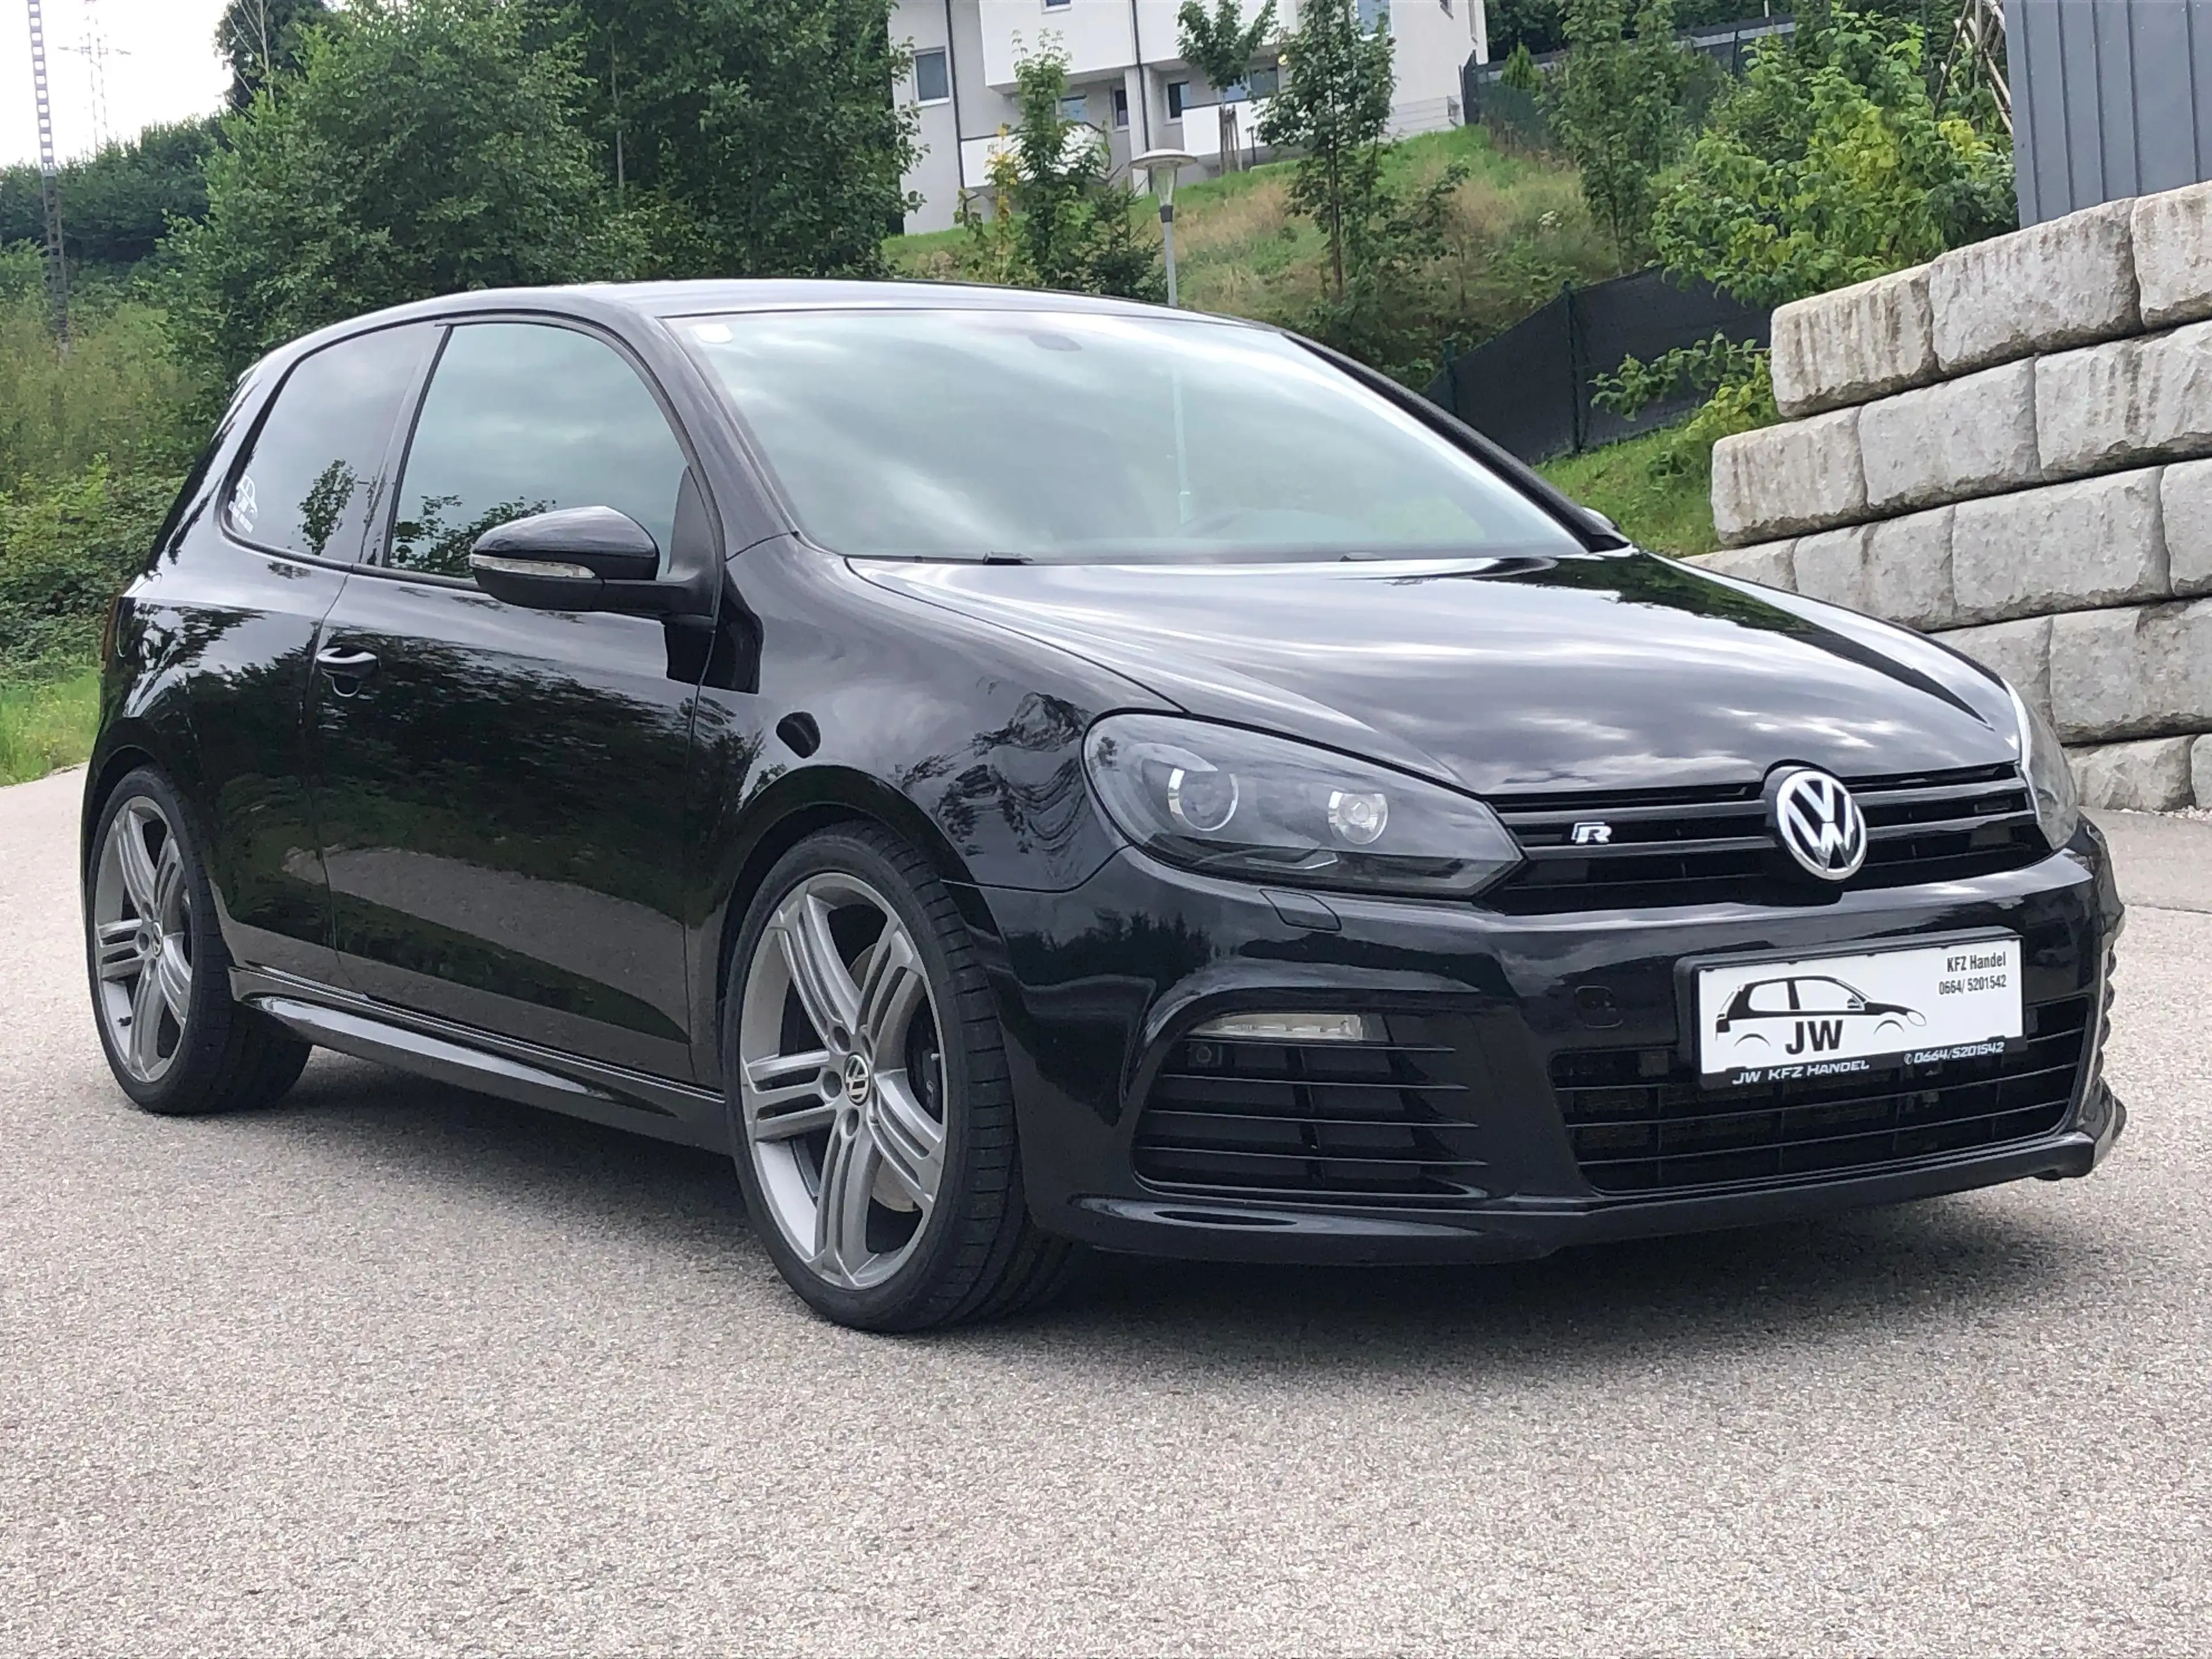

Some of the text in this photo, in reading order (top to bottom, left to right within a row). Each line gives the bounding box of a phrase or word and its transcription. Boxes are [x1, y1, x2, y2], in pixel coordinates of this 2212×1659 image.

[1571, 821, 1612, 844] R
[1947, 951, 2006, 972] KFZ Handel
[1967, 974, 2007, 991] 5201542
[1786, 1020, 1843, 1055] JW
[1914, 1041, 2005, 1064] 0664/5201542
[1732, 1060, 1870, 1085] JW KFZ HANDEL
